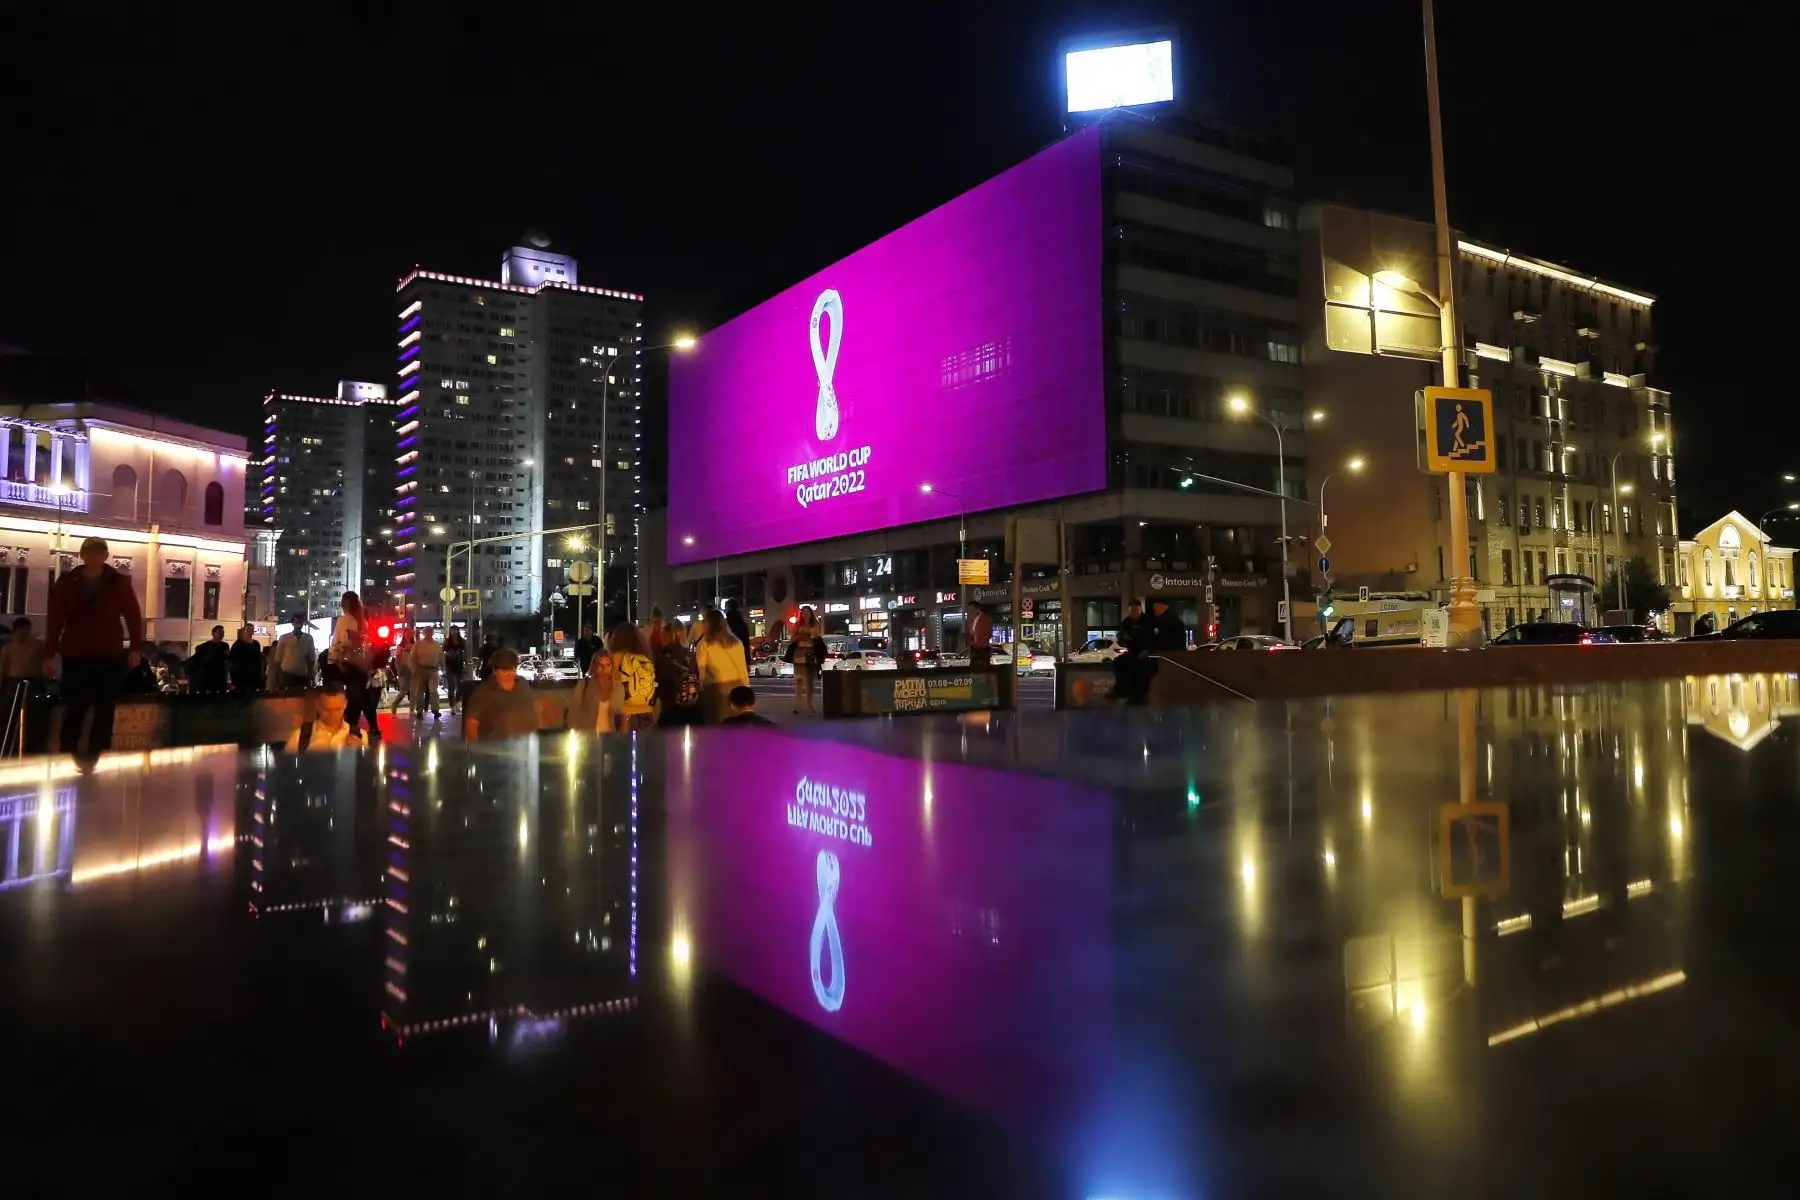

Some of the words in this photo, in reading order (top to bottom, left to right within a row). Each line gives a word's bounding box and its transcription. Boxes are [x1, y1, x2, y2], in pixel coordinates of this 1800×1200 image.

[787, 465, 809, 484] FIFA
[809, 453, 848, 477] WORLD
[849, 446, 872, 467] CUP
[1165, 577, 1202, 586] Intourist
[904, 595, 916, 604] KFC
[943, 592, 957, 601] KFC
[894, 678, 925, 689] РИТМ
